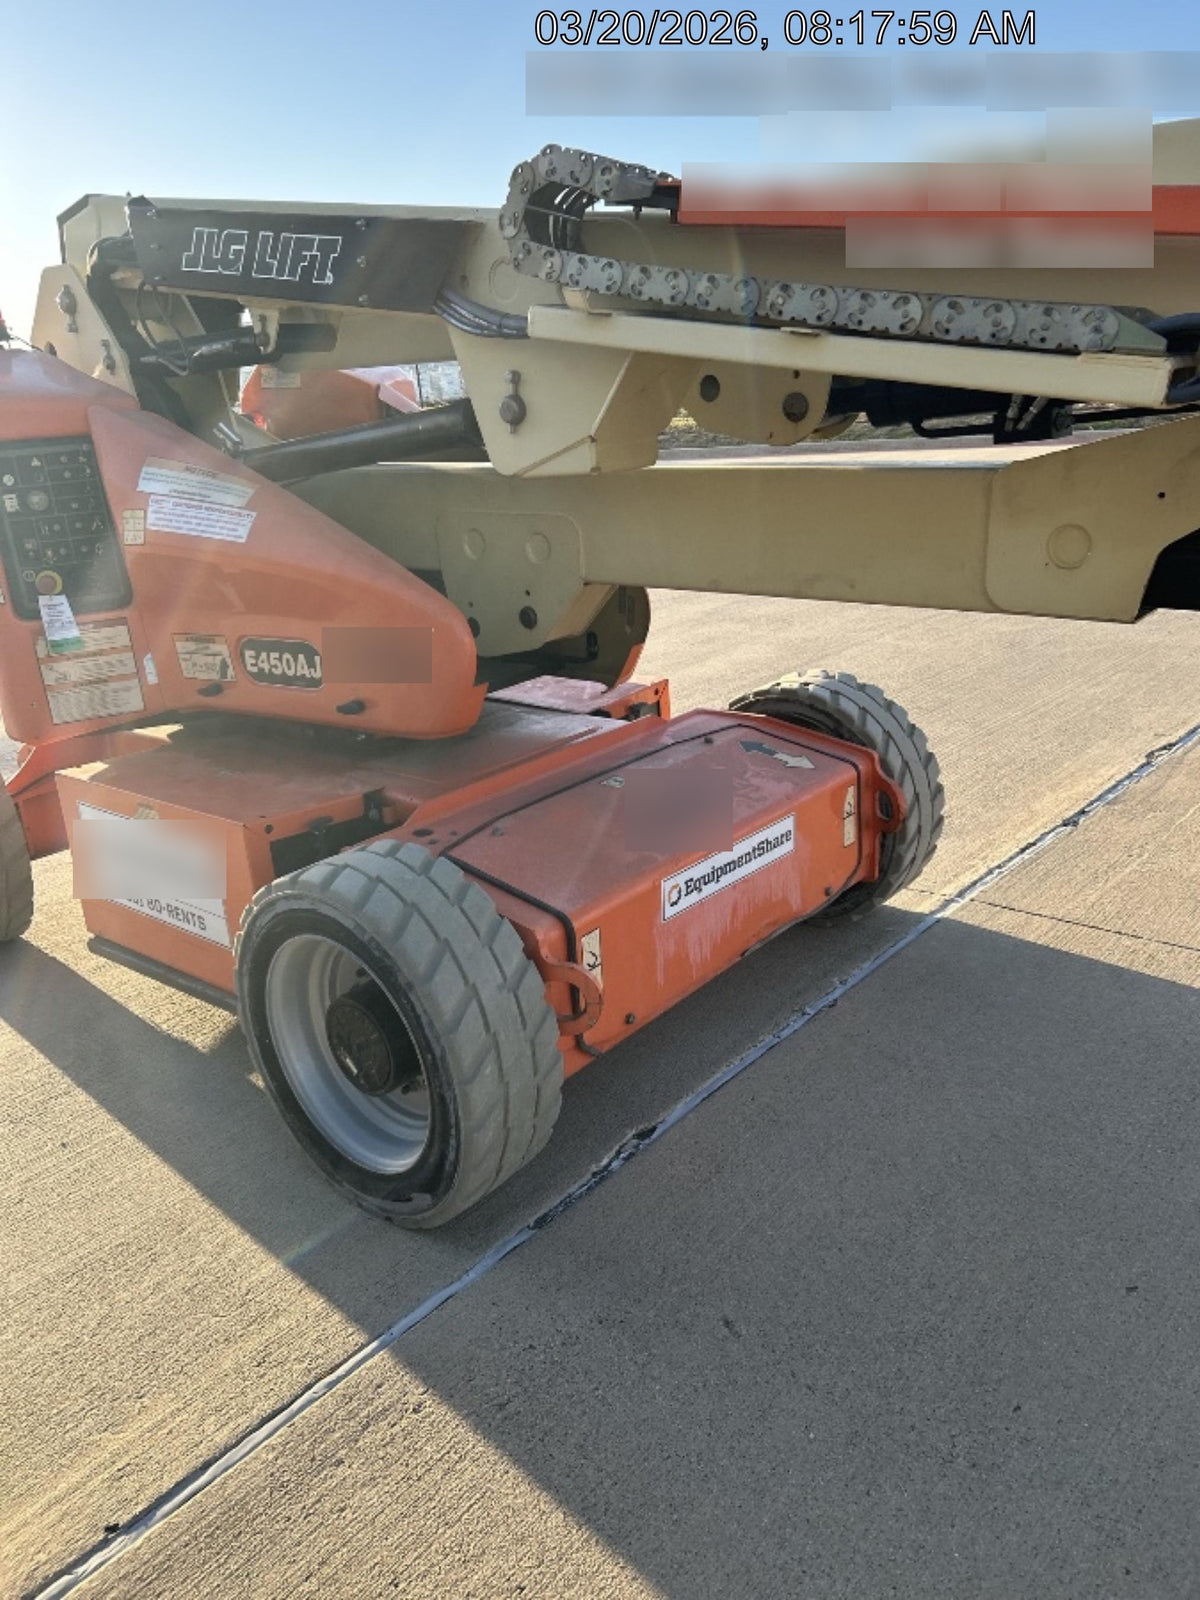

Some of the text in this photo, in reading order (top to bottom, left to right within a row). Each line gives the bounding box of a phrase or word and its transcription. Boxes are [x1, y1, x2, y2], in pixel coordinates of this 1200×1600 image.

[181, 228, 342, 283] JLG LIFT
[245, 650, 321, 679] E450AJ
[684, 829, 792, 897] EquipmentShare
